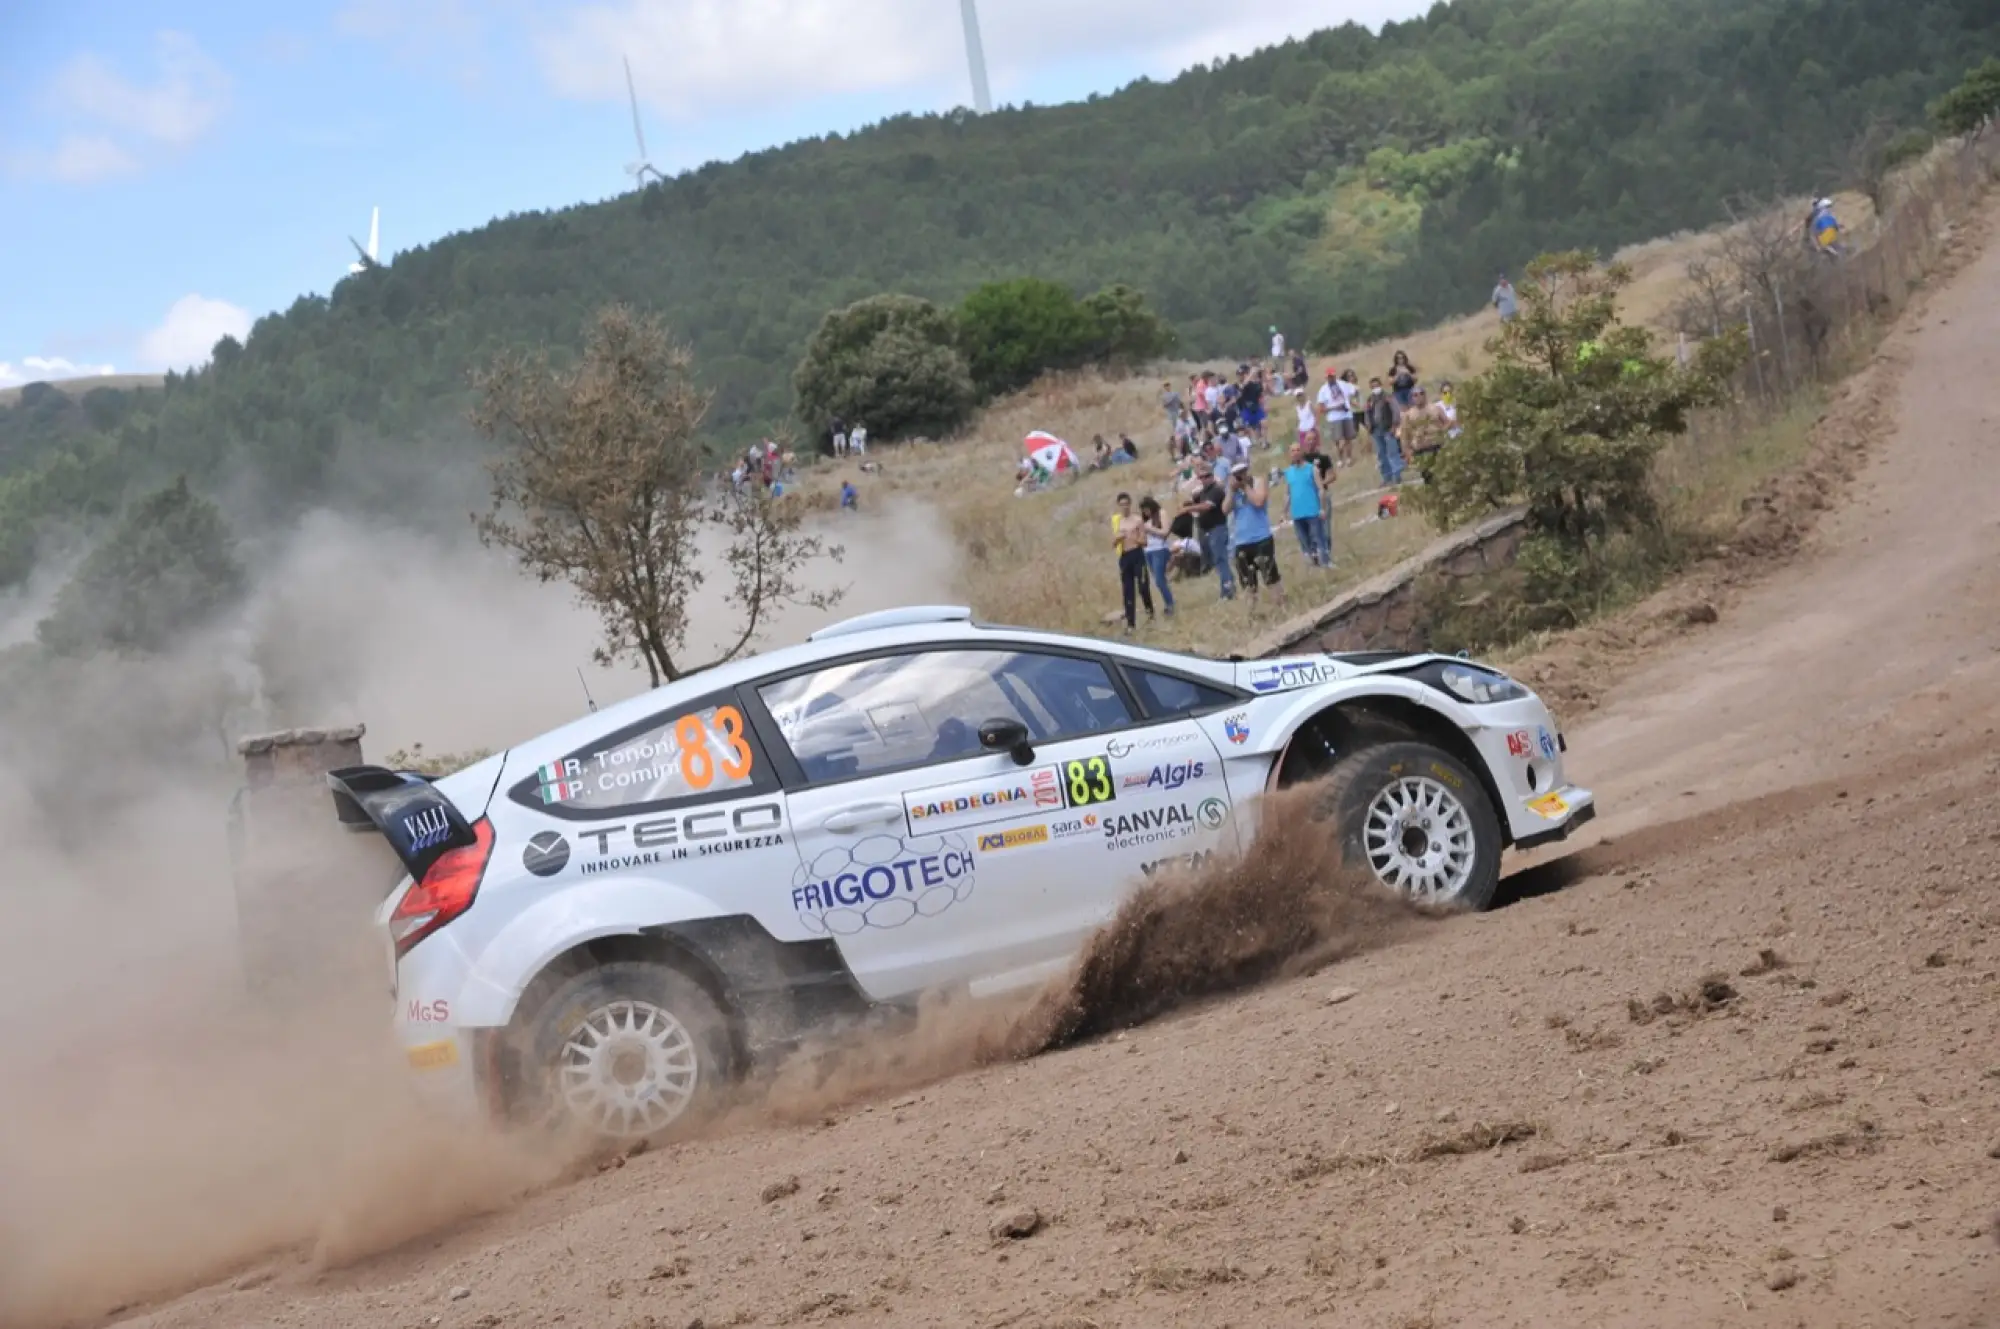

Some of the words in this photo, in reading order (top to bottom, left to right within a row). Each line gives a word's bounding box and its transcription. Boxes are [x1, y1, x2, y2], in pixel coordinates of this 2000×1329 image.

[675, 705, 753, 790] 83
[1068, 756, 1111, 806] 83
[1147, 759, 1204, 790] Algis
[911, 786, 1027, 819] SARDEGNA
[1031, 770, 1058, 808] 2016
[403, 805, 449, 841] VALLI
[578, 802, 782, 855] TECO
[1004, 827, 1048, 843] GLOBAL
[1052, 820, 1082, 835] sara
[1103, 803, 1195, 837] SANVAL
[1107, 827, 1176, 851] electronic
[1180, 821, 1196, 838] srl
[580, 851, 661, 875] INNOVARE
[672, 847, 688, 860] IN
[699, 834, 784, 857] SICUREZZA
[791, 851, 975, 911] FRIGOTECH
